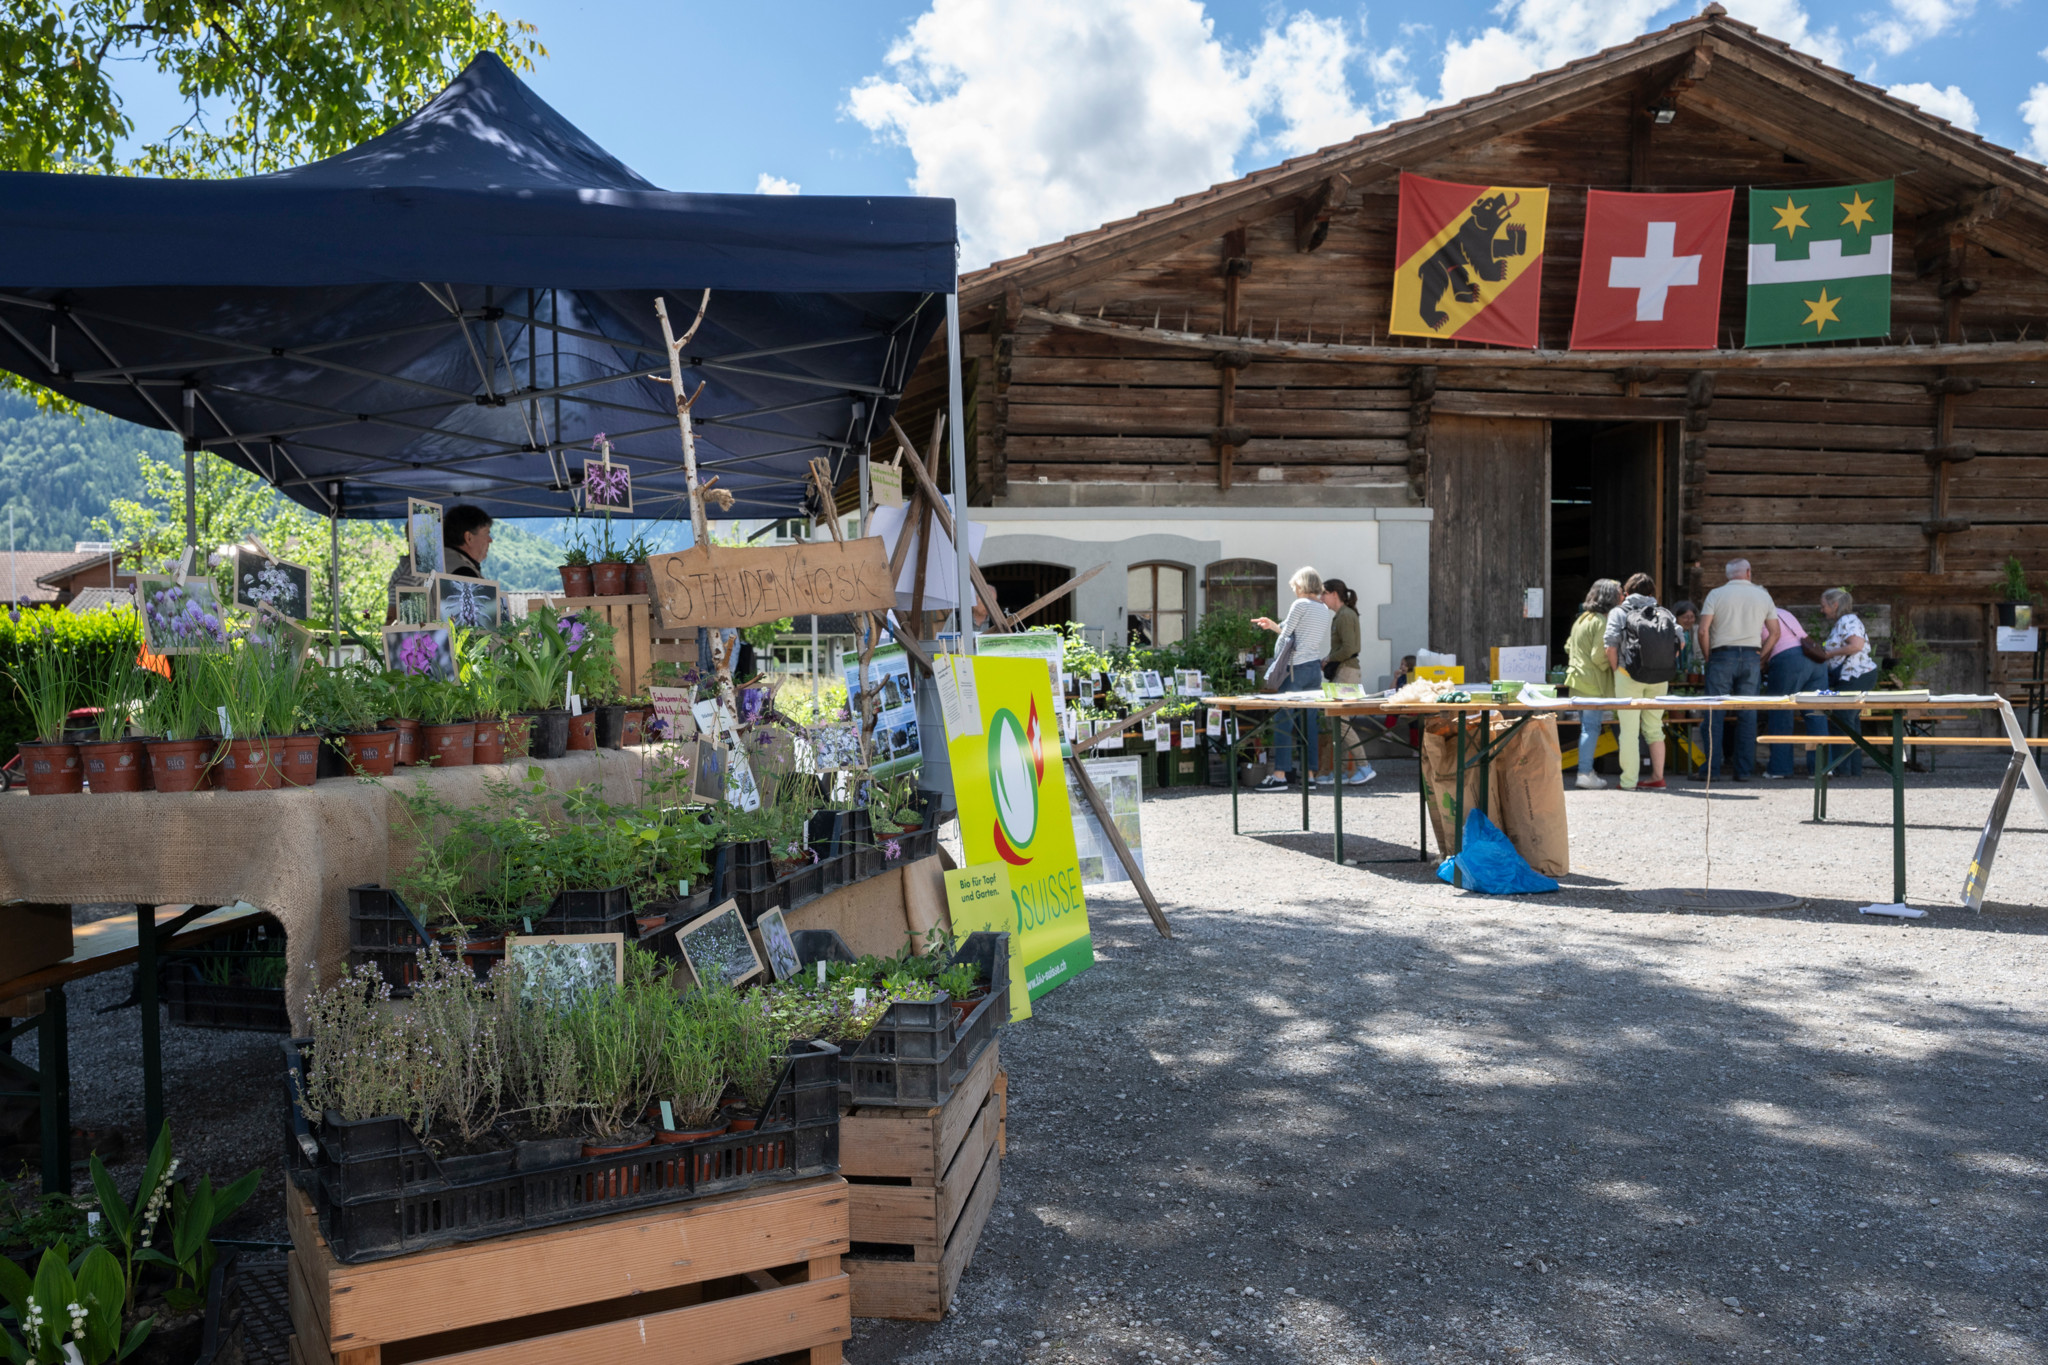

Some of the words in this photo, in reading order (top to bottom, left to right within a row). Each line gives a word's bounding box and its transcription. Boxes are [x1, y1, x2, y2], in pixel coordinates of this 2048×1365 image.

[960, 879, 971, 889] Bio
[972, 876, 981, 887] für
[982, 872, 996, 886] Topf
[961, 891, 974, 902] und
[975, 889, 999, 899] Garten.
